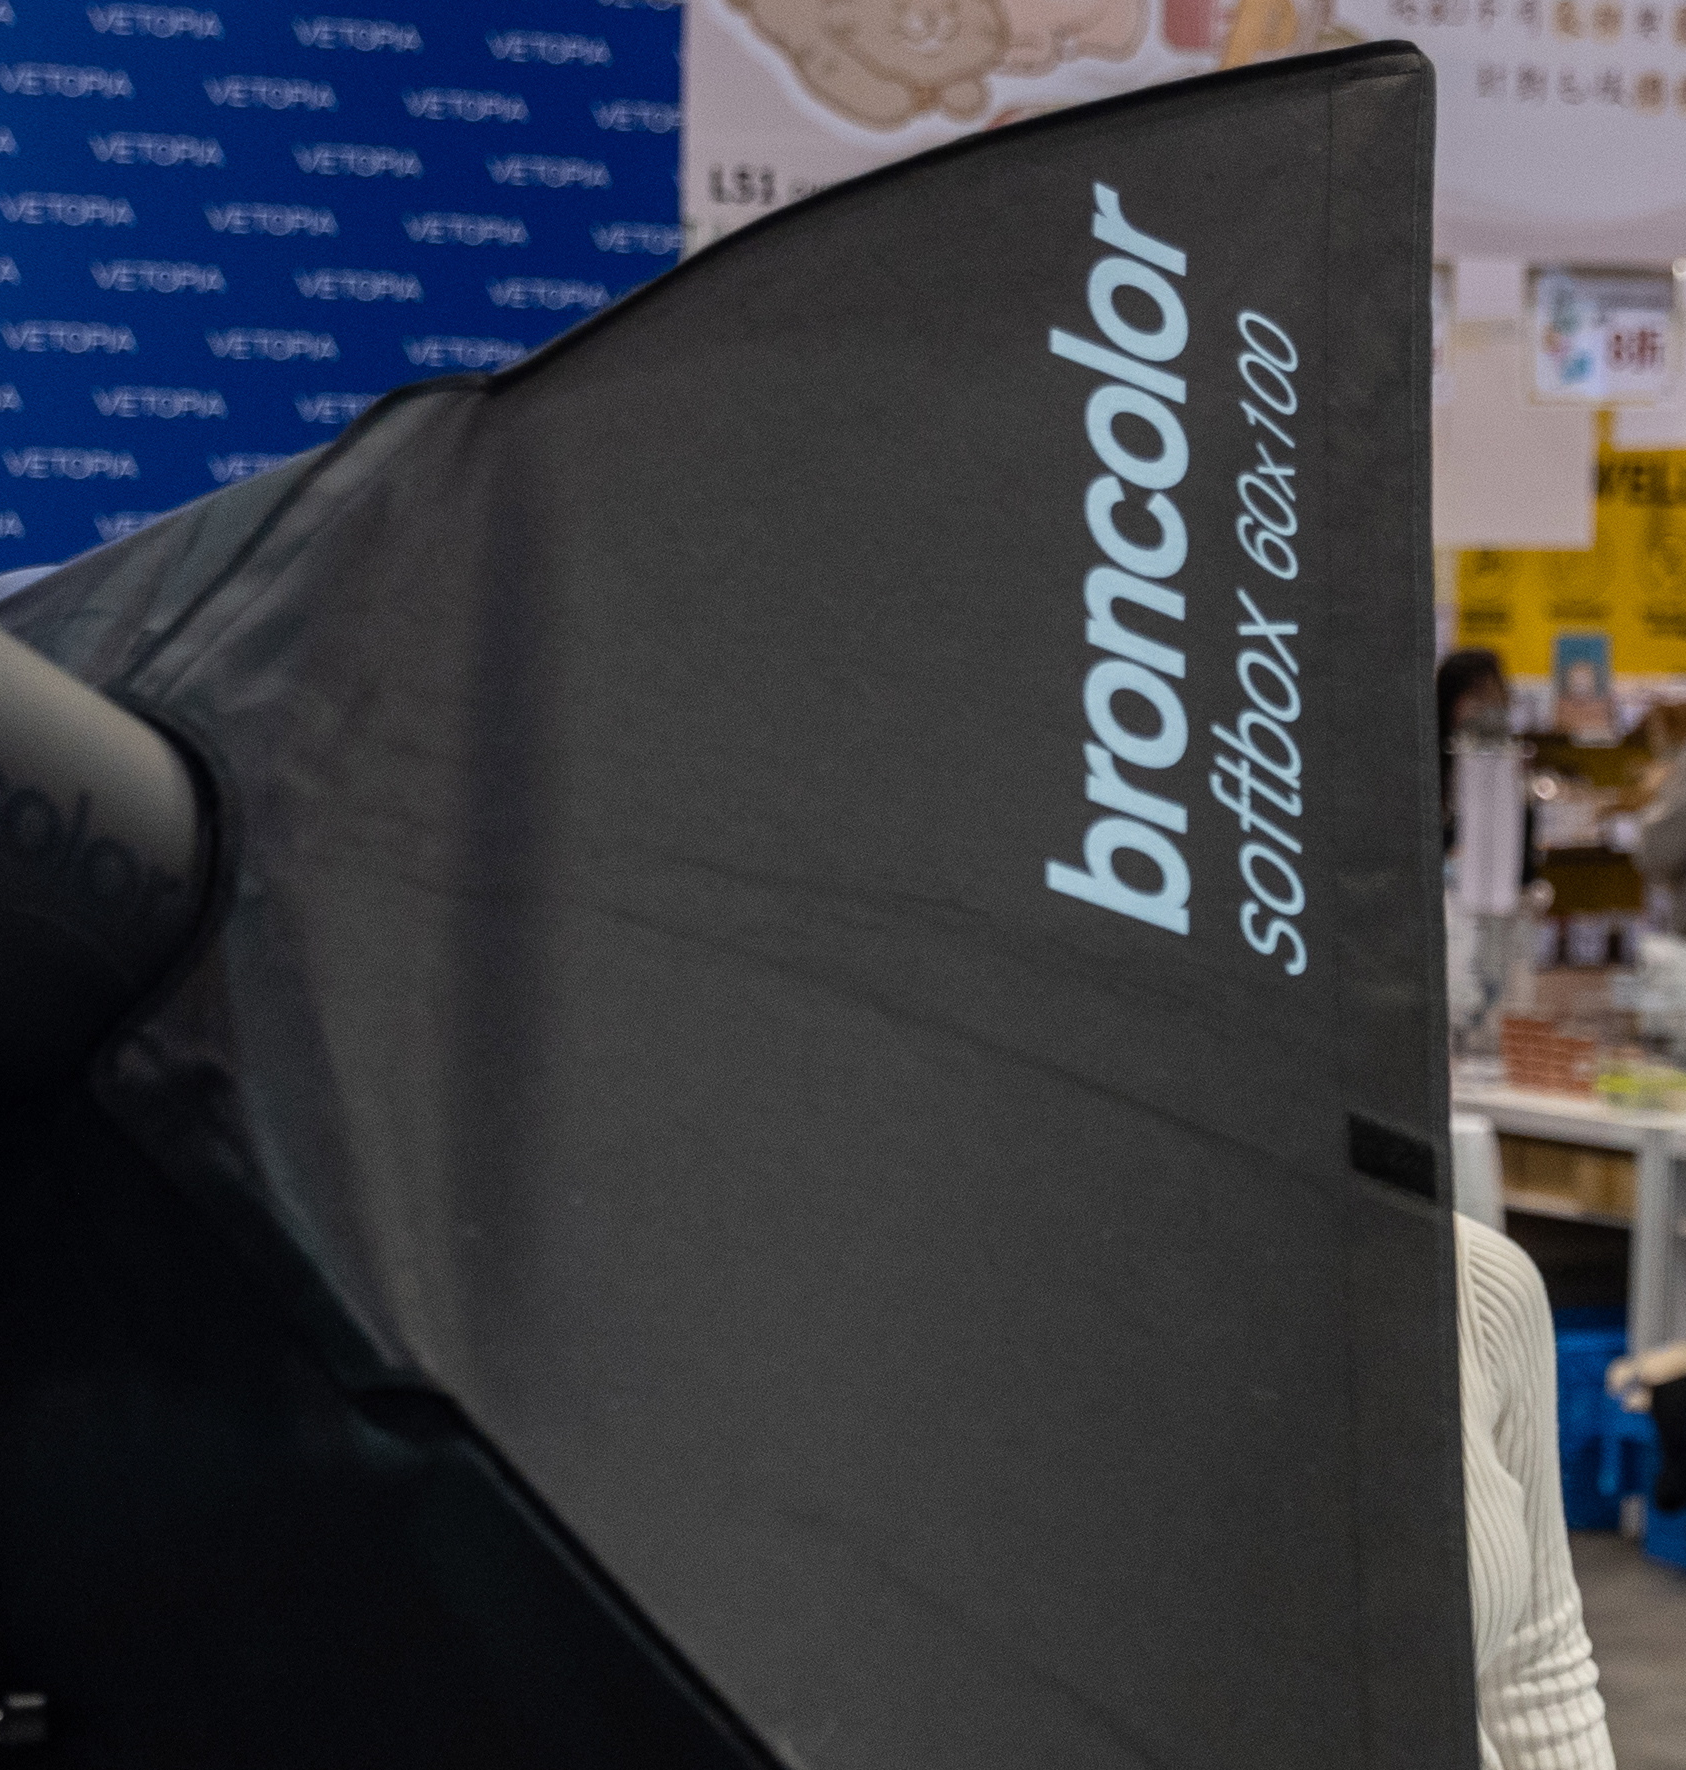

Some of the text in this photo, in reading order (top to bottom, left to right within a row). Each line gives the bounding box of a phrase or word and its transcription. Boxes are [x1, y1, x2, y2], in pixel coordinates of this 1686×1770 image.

[1045, 181, 1192, 936] broncolor
[1210, 309, 1308, 977] softbox 60x100
